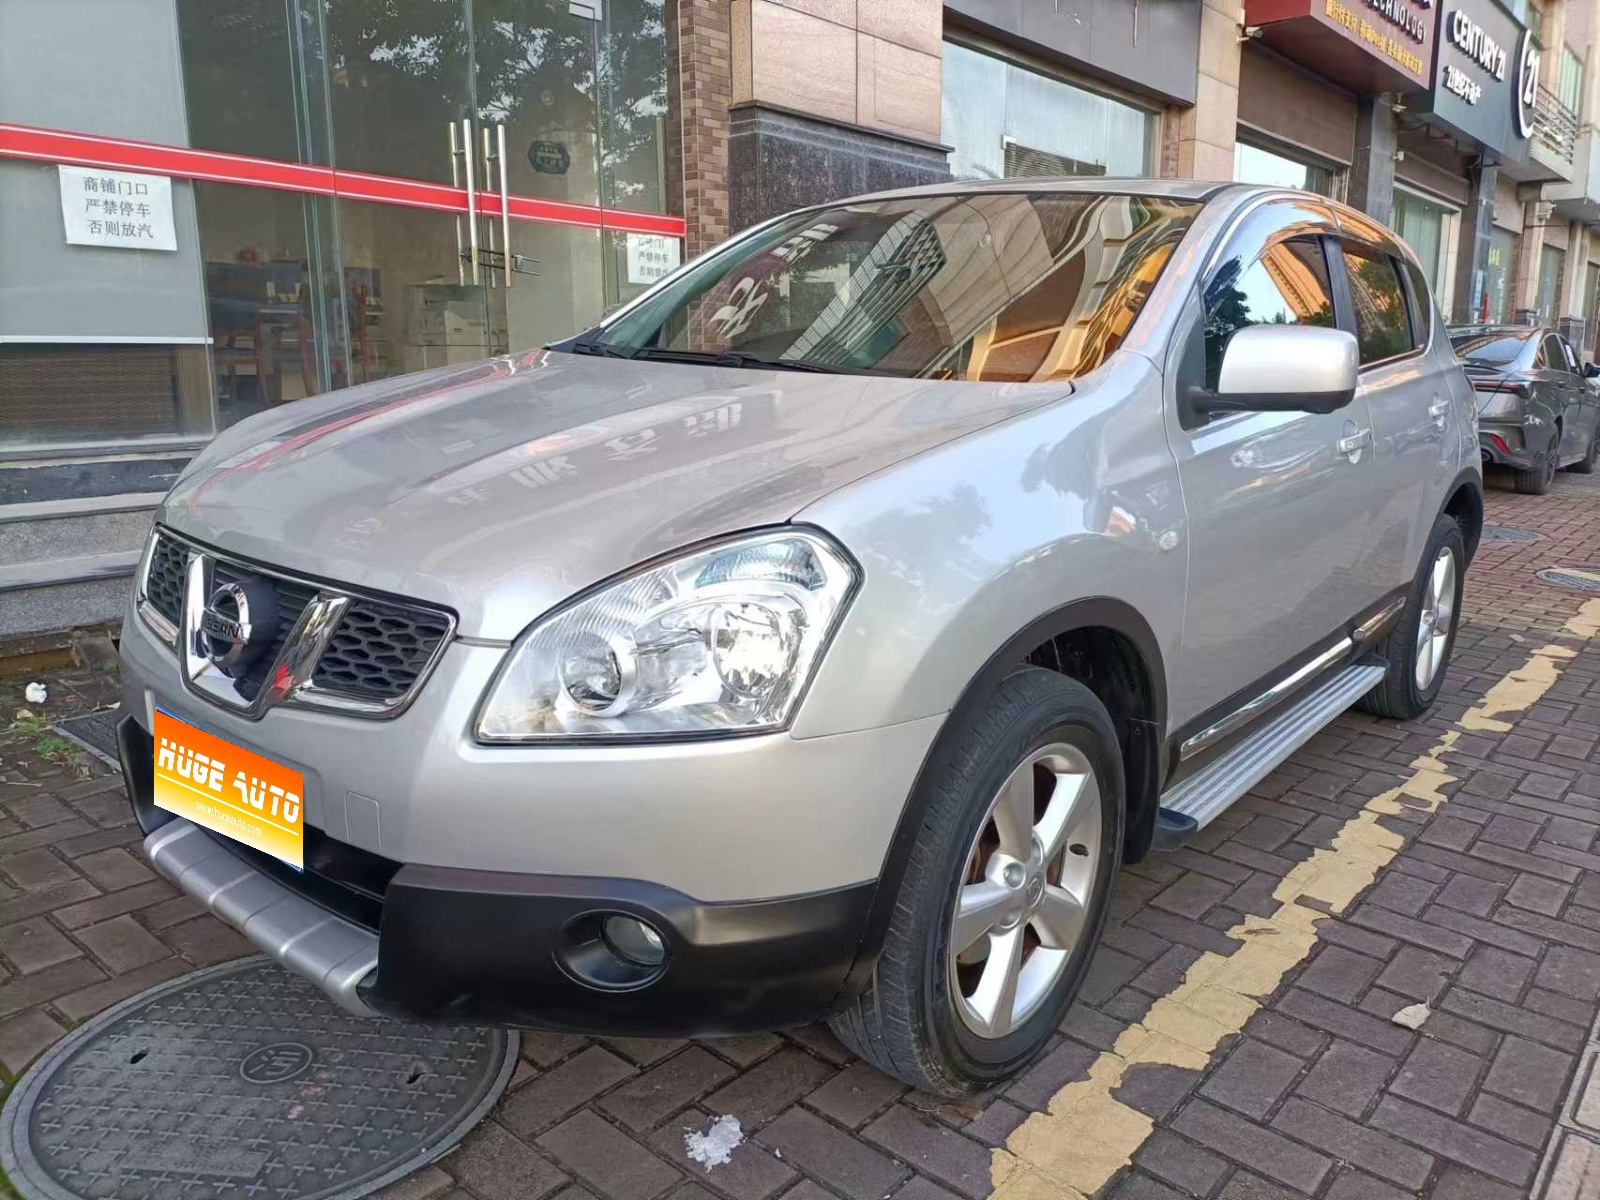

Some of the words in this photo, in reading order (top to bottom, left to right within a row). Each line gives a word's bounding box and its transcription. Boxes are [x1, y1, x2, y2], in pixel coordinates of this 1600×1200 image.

[1367, 0, 1427, 42] CHNOLOGY
[1453, 9, 1499, 73] CENTURY
[1496, 48, 1507, 82] 21
[1523, 49, 1540, 108] 21
[83, 176, 148, 195] 商铺门口
[84, 198, 151, 218] 严禁停车
[87, 219, 154, 239] 否则放汽
[249, 1048, 302, 1076] 污
